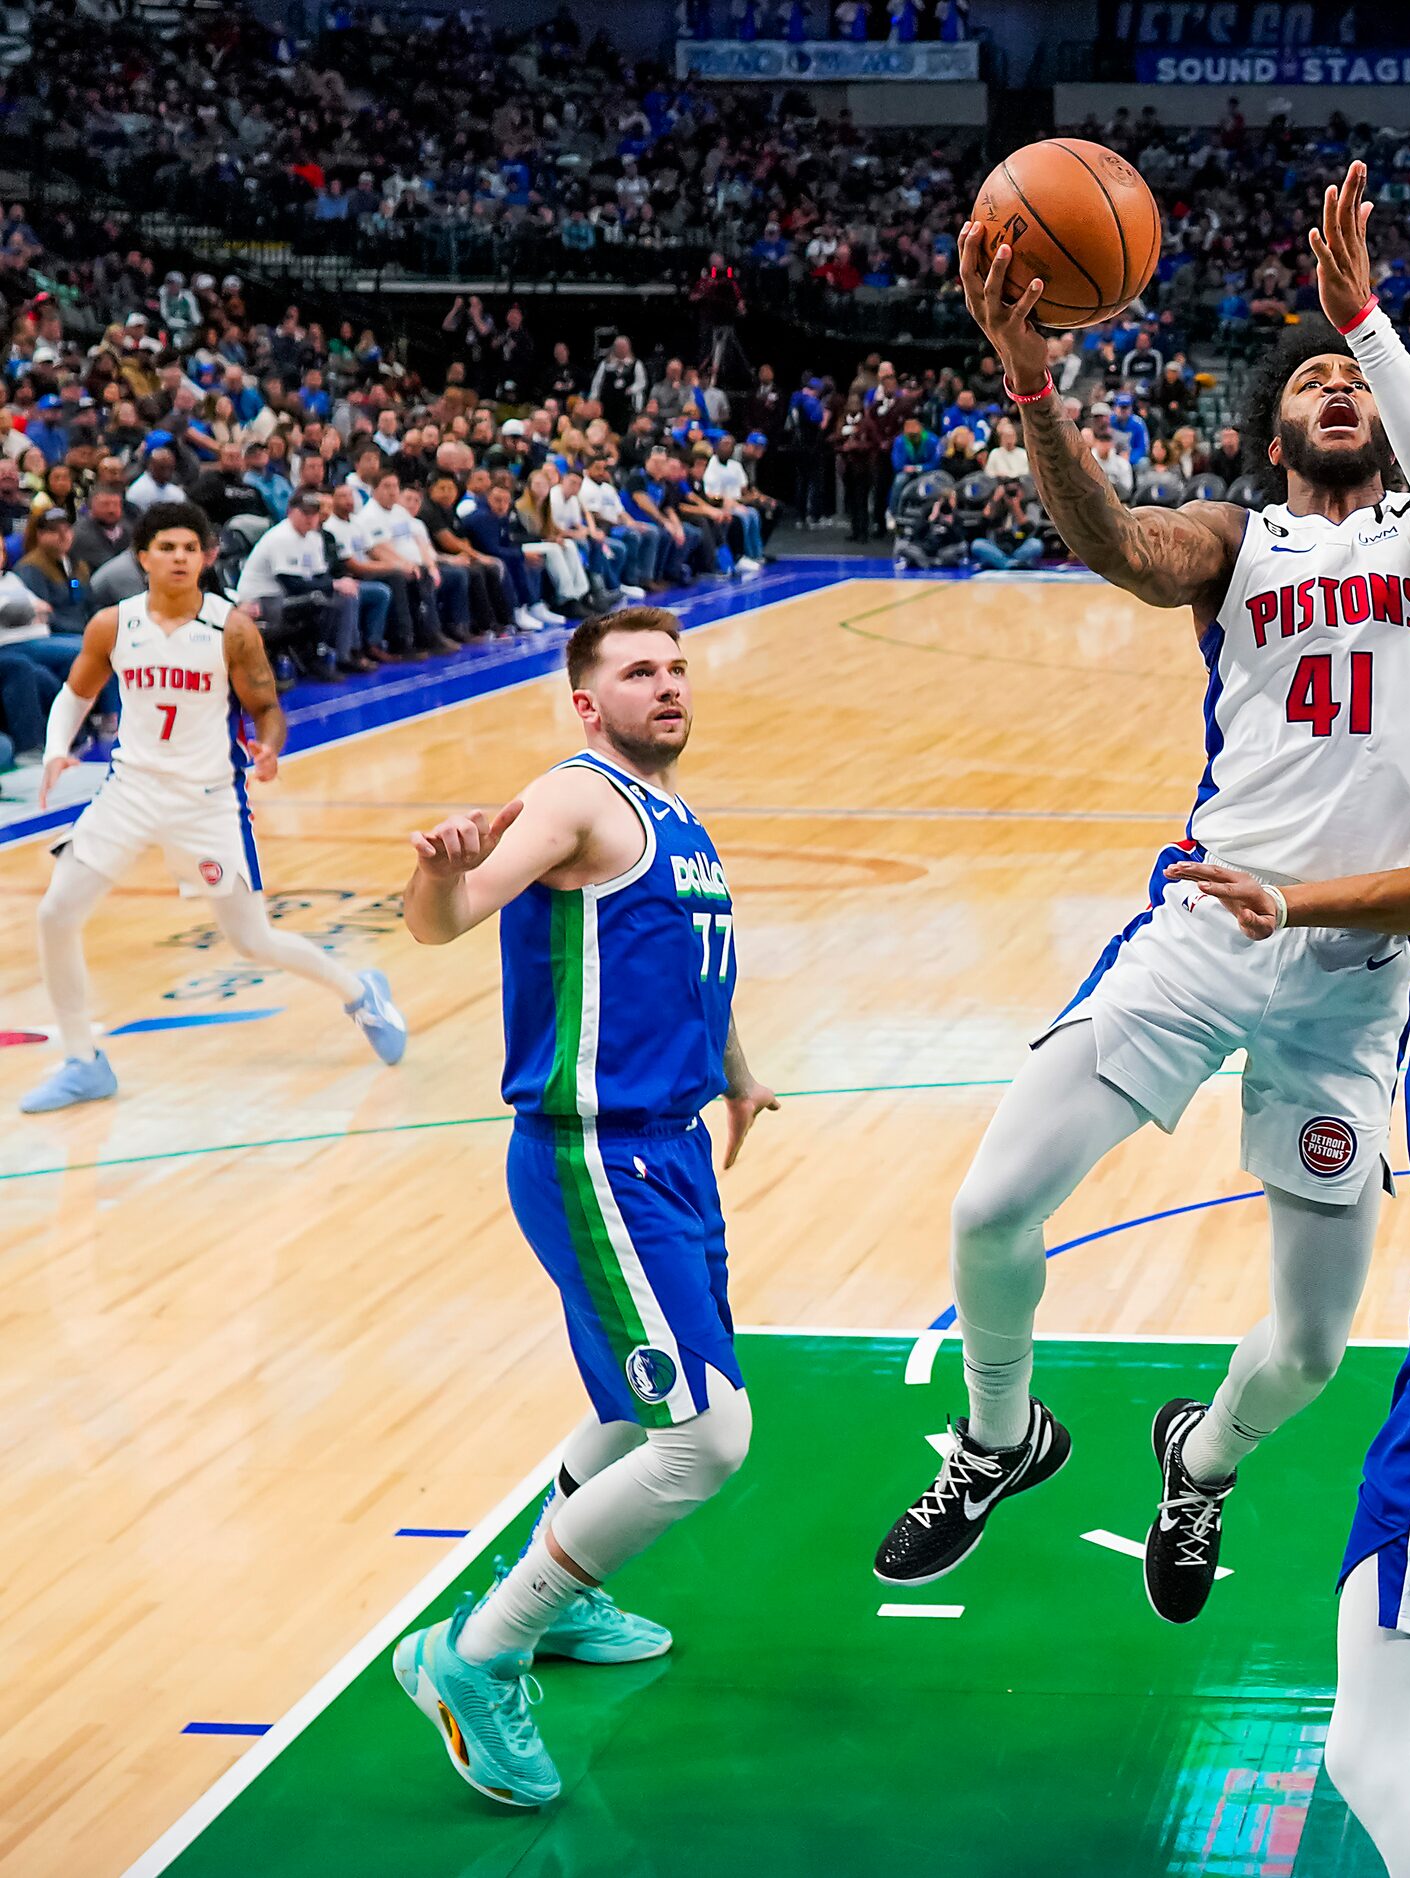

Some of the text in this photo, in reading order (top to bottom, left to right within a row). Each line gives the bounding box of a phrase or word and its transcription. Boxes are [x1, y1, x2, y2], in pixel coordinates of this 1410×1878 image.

[1156, 56, 1278, 83] SOUND
[122, 666, 213, 692] PISTONS
[1286, 651, 1373, 737] 41
[156, 704, 177, 741] 7
[693, 912, 734, 984] 77
[1307, 1142, 1345, 1160] PISTONS
[1310, 1132, 1346, 1150] DETROIT
